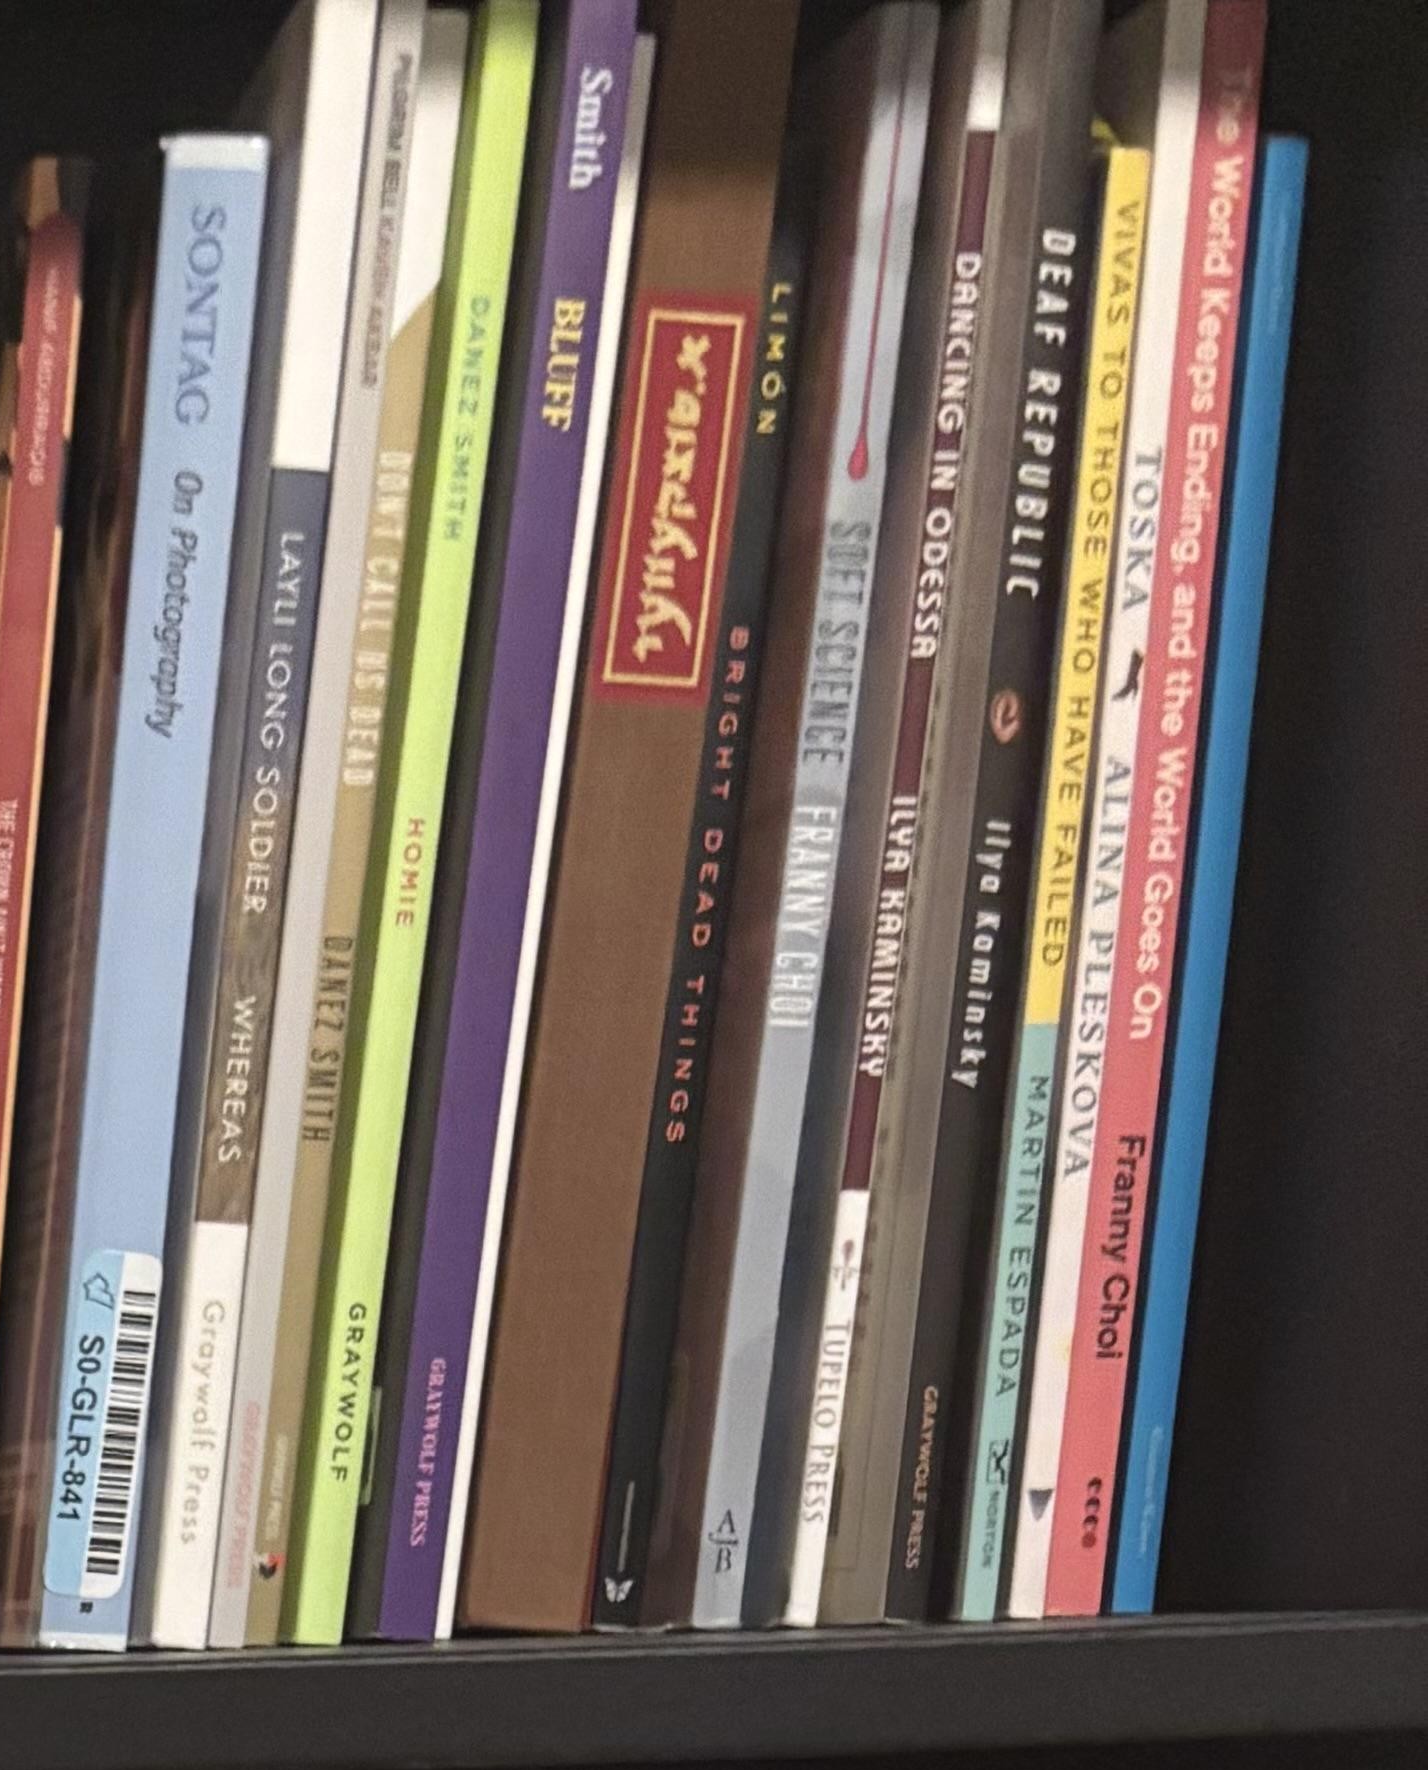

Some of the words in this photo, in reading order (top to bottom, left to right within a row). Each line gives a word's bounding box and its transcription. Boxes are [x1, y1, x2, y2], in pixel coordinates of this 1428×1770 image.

[568, 67, 613, 190] Smith
[1107, 201, 1140, 325] VIVAS
[1204, 155, 1245, 276] World
[175, 205, 226, 426] SONTAG
[1035, 229, 1076, 349] DEAF
[465, 296, 490, 419] DANEZ
[542, 299, 585, 432] BLUFF
[756, 283, 792, 436] LIMÓN
[1099, 349, 1128, 398] TO
[1192, 289, 1230, 413] Keeps
[172, 470, 204, 517] On
[444, 434, 473, 542] SMITH
[1006, 372, 1062, 600] REPUBLIC
[1082, 424, 1120, 555] THOSE
[146, 526, 199, 739] Photography
[1072, 584, 1107, 675] WHO
[1167, 585, 1197, 659] and
[710, 625, 749, 800] BRIGHT
[1059, 696, 1090, 802] HAVE
[1162, 673, 1192, 737] the
[976, 821, 1012, 893] Ilya
[1148, 748, 1187, 863] World
[395, 818, 424, 925] HOMIE
[691, 829, 722, 947] DEAD
[1042, 824, 1076, 967] FAILED
[1136, 873, 1175, 974] Goes
[666, 975, 703, 1143] THINGS
[951, 912, 999, 1090] Kaminsky
[1130, 987, 1162, 1041] On
[1102, 1134, 1145, 1264] Franny
[811, 1322, 850, 1428] TUPELO
[1096, 1274, 1131, 1361] Choi
[332, 1304, 365, 1482] GRAYWOLF
[803, 1444, 833, 1523] PRESS
